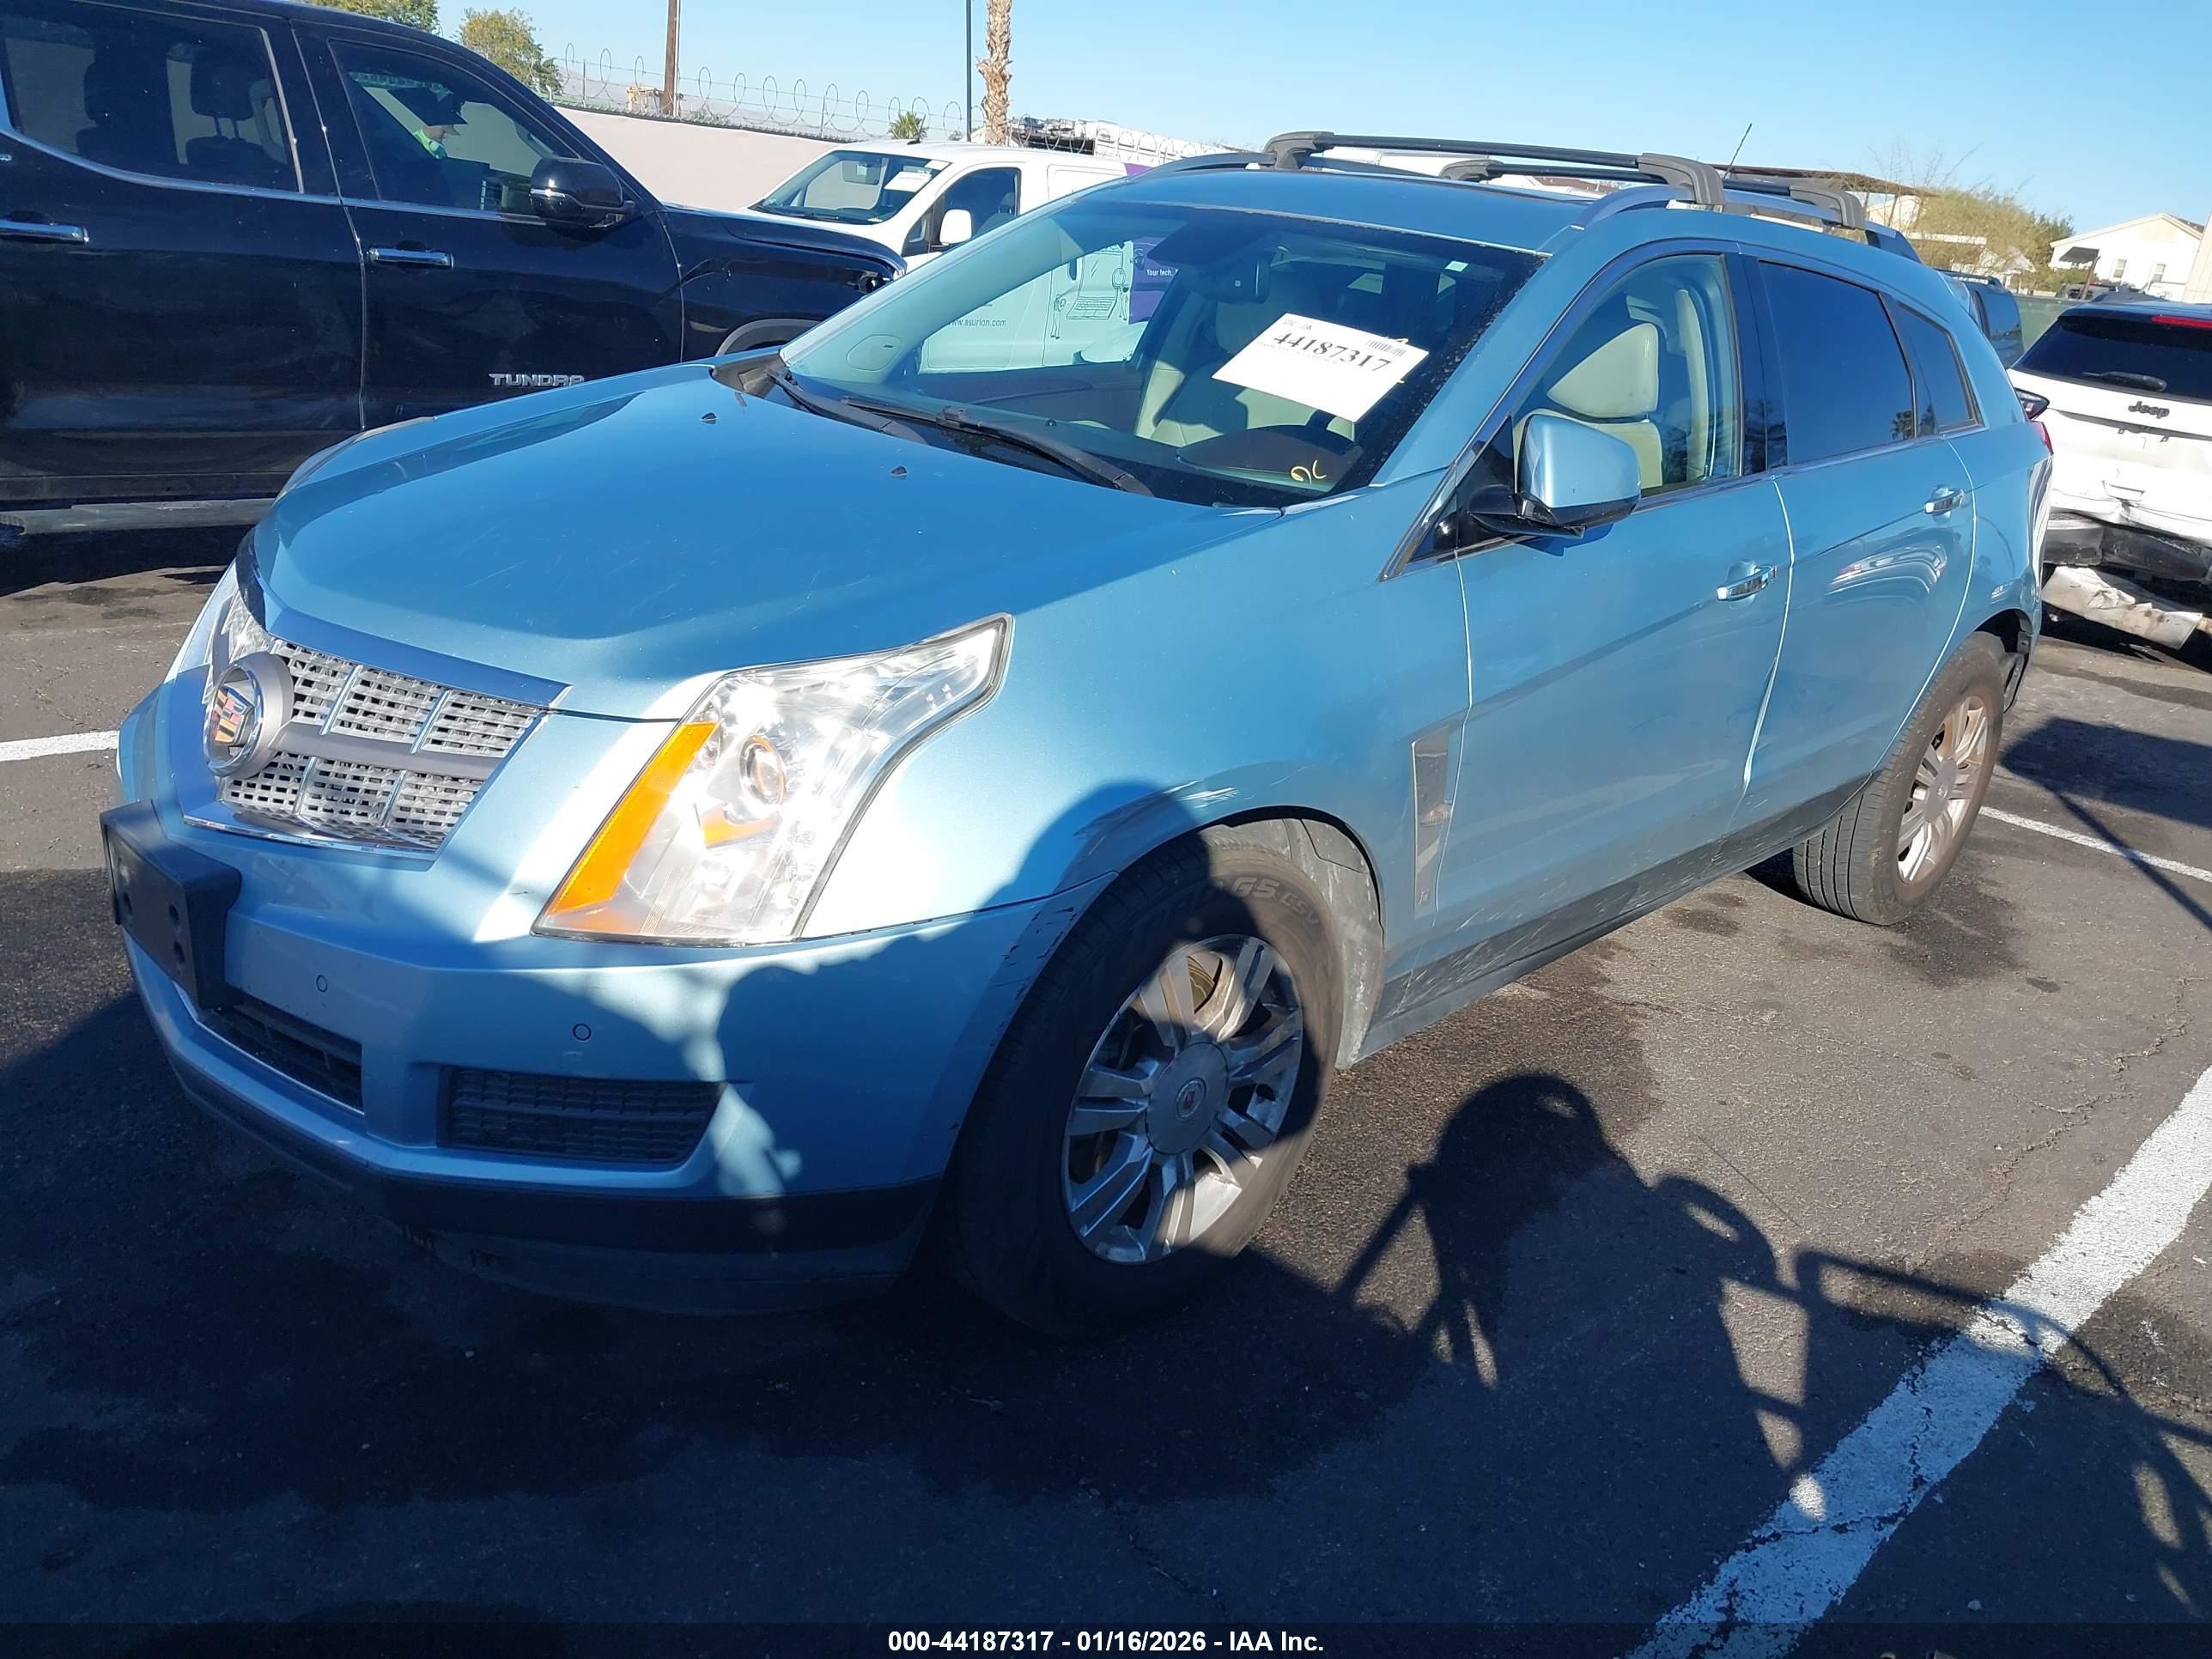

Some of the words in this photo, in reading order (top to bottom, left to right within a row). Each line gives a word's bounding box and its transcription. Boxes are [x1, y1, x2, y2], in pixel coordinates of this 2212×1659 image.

[1273, 332, 1392, 372] 44187317
[489, 373, 585, 386] TUNDRA
[2128, 400, 2170, 419] Jeep
